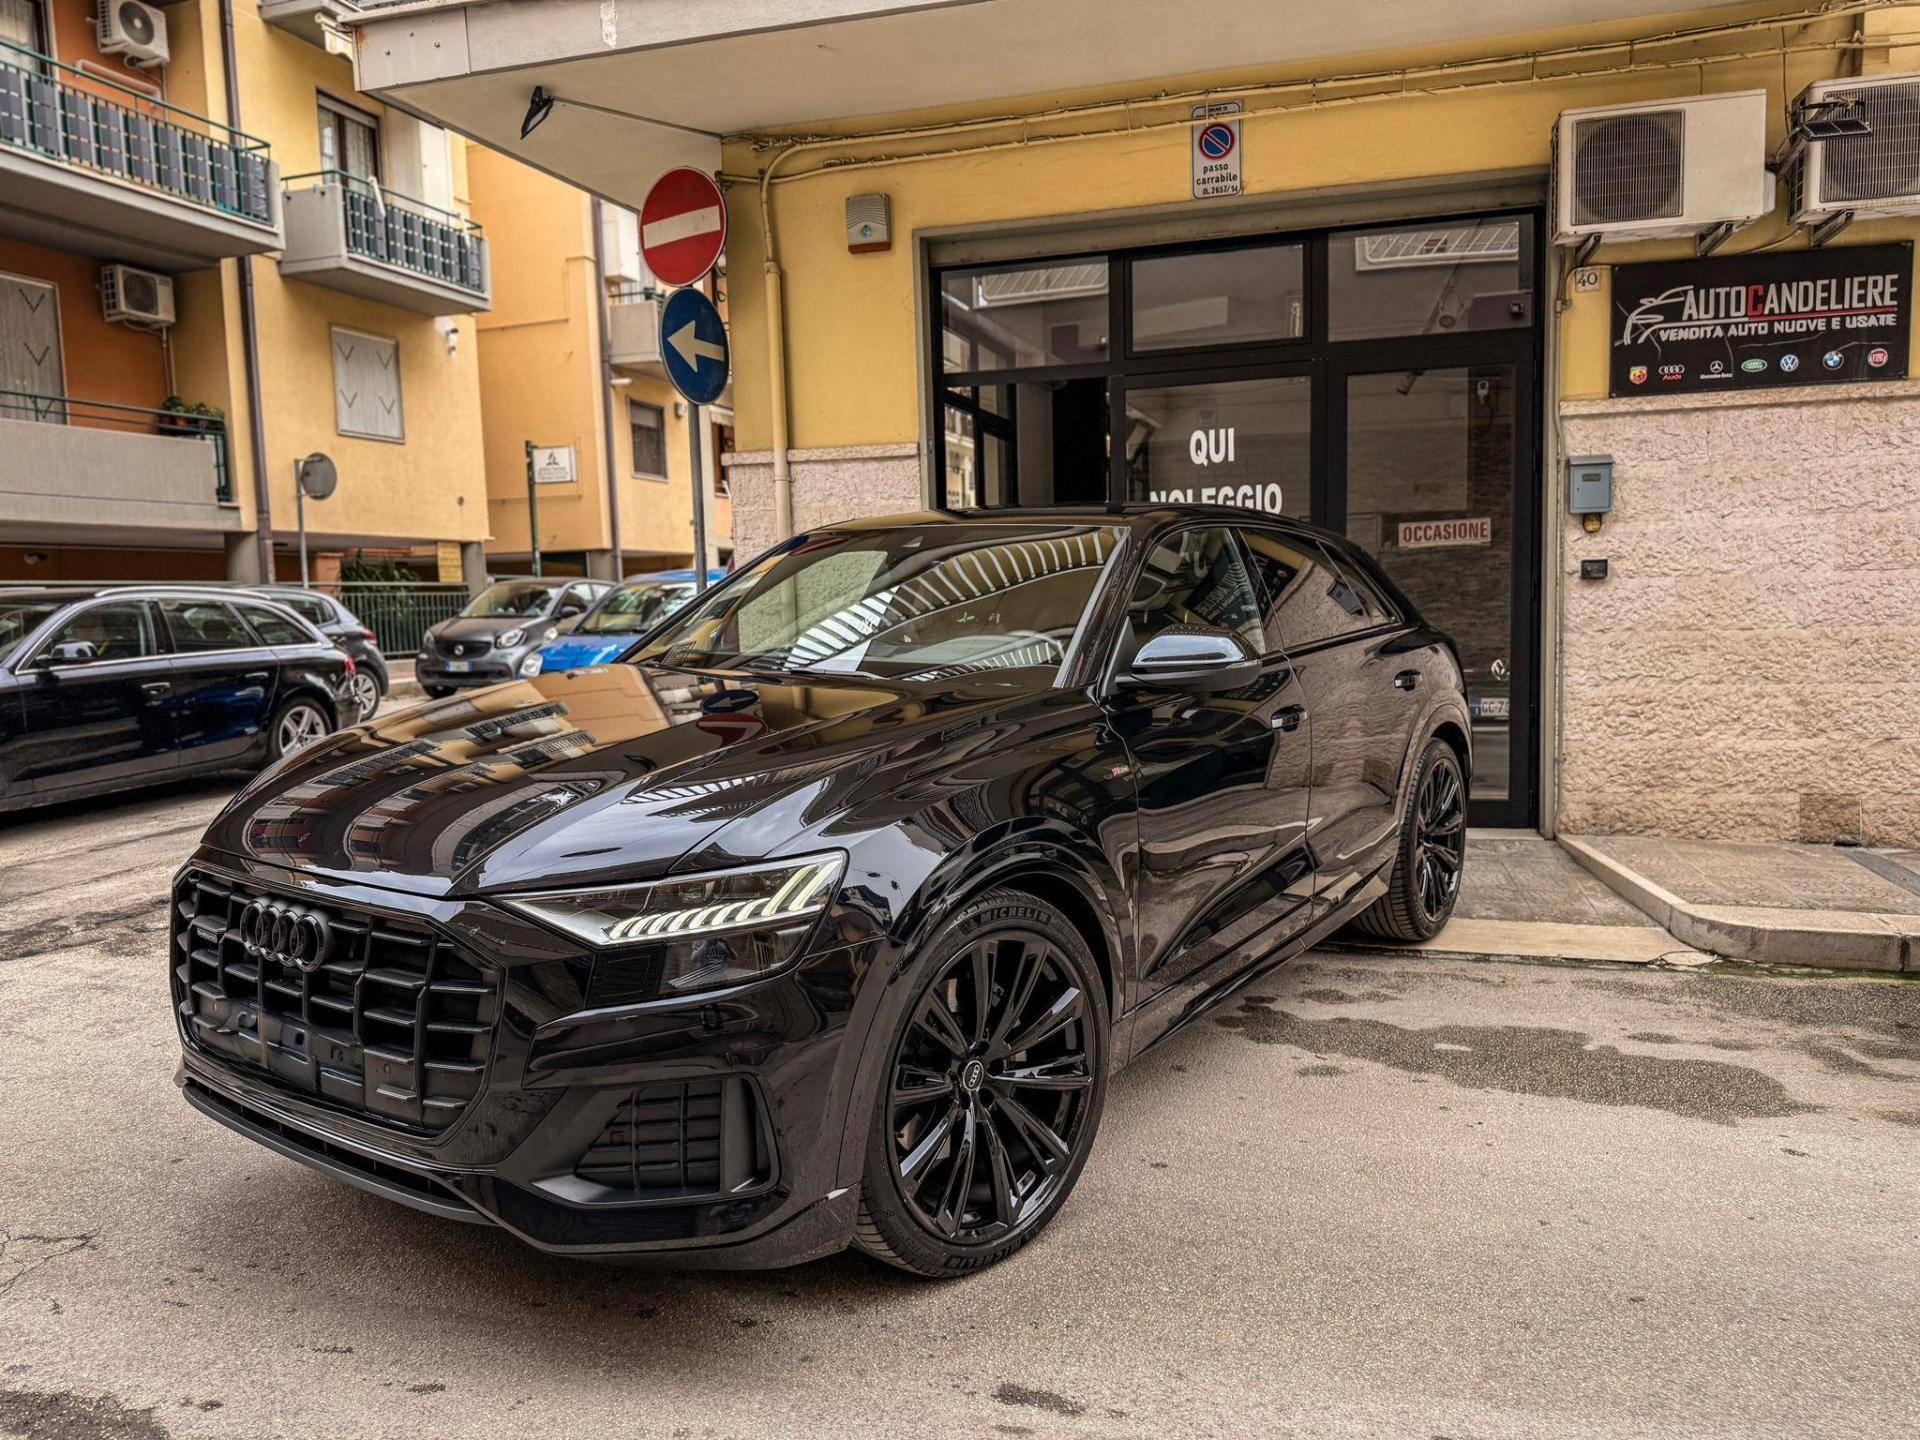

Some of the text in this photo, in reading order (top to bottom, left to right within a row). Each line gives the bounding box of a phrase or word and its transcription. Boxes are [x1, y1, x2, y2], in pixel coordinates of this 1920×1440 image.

[1196, 172, 1238, 186] carrabile
[1203, 163, 1229, 175] passo
[1577, 272, 1598, 287] 40
[1682, 273, 1899, 321] AUTOCANDELIERE
[1659, 313, 1898, 342] VENDITA AUTO NUOVE E USATE
[1189, 428, 1235, 467] QUI
[1403, 521, 1488, 543] OCCASIONE
[980, 906, 1049, 925] MICHELIN
